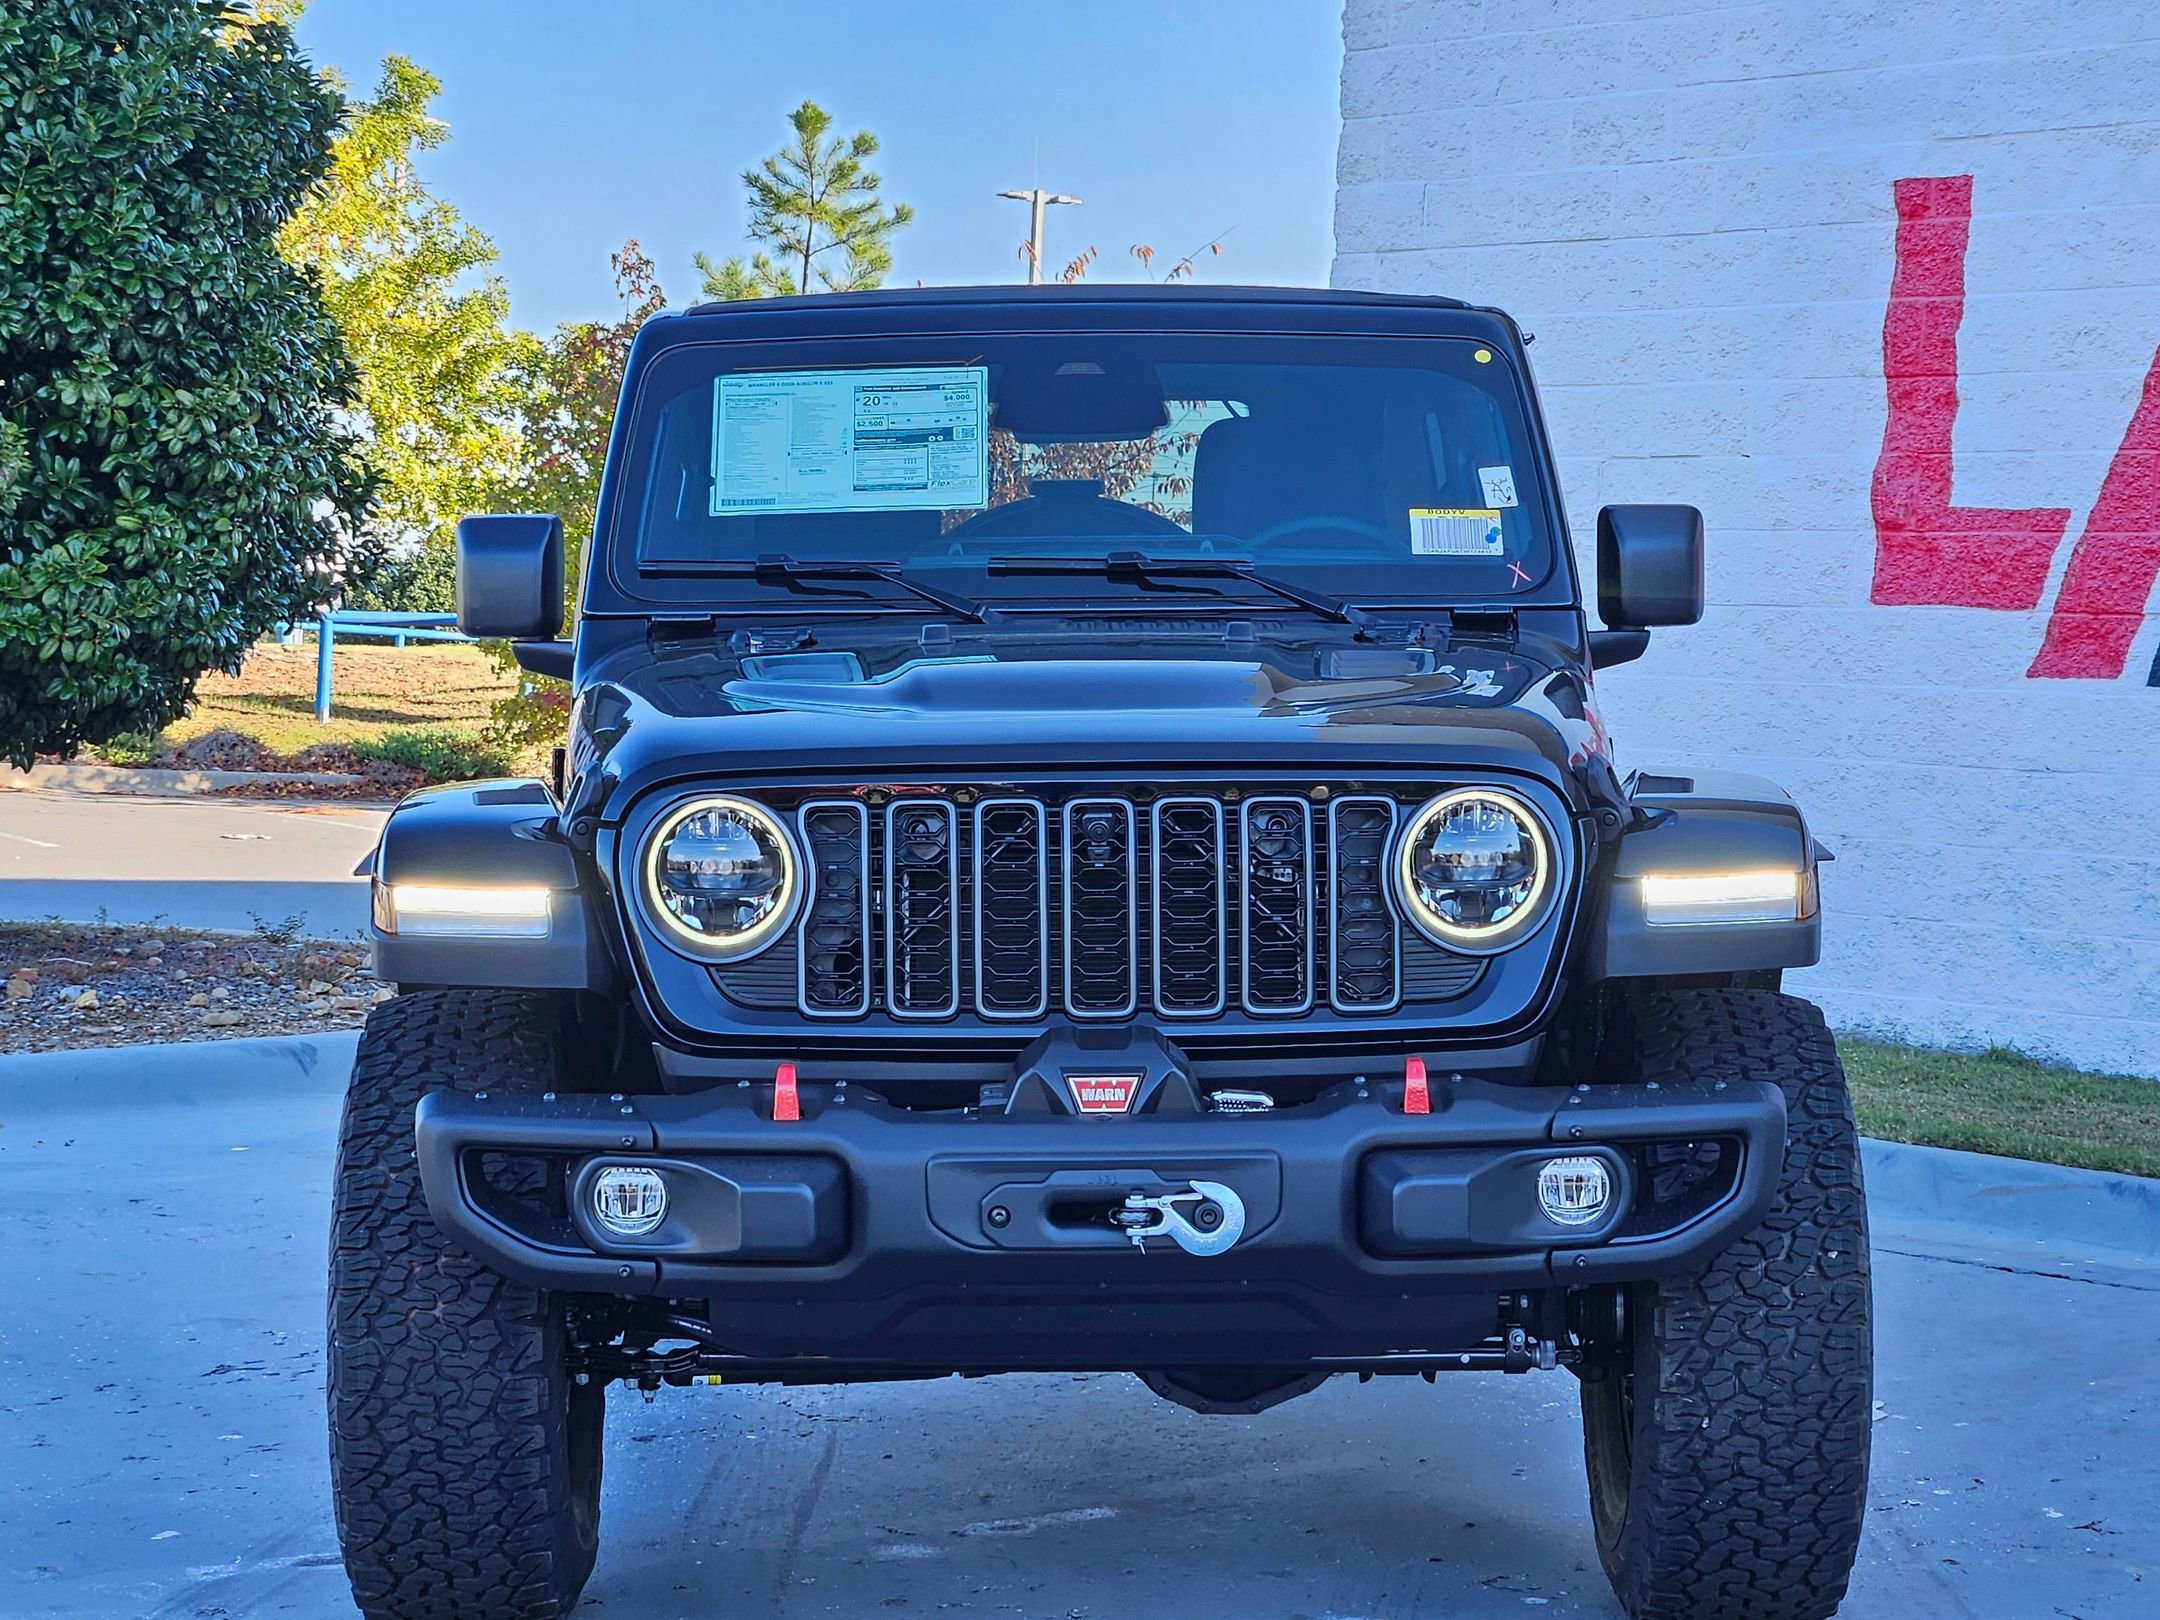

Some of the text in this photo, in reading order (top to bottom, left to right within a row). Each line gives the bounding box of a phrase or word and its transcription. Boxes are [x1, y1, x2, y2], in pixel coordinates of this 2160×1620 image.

[862, 396, 881, 406] 20
[943, 393, 970, 401] $4,000
[1081, 1087, 1126, 1102] WARN
